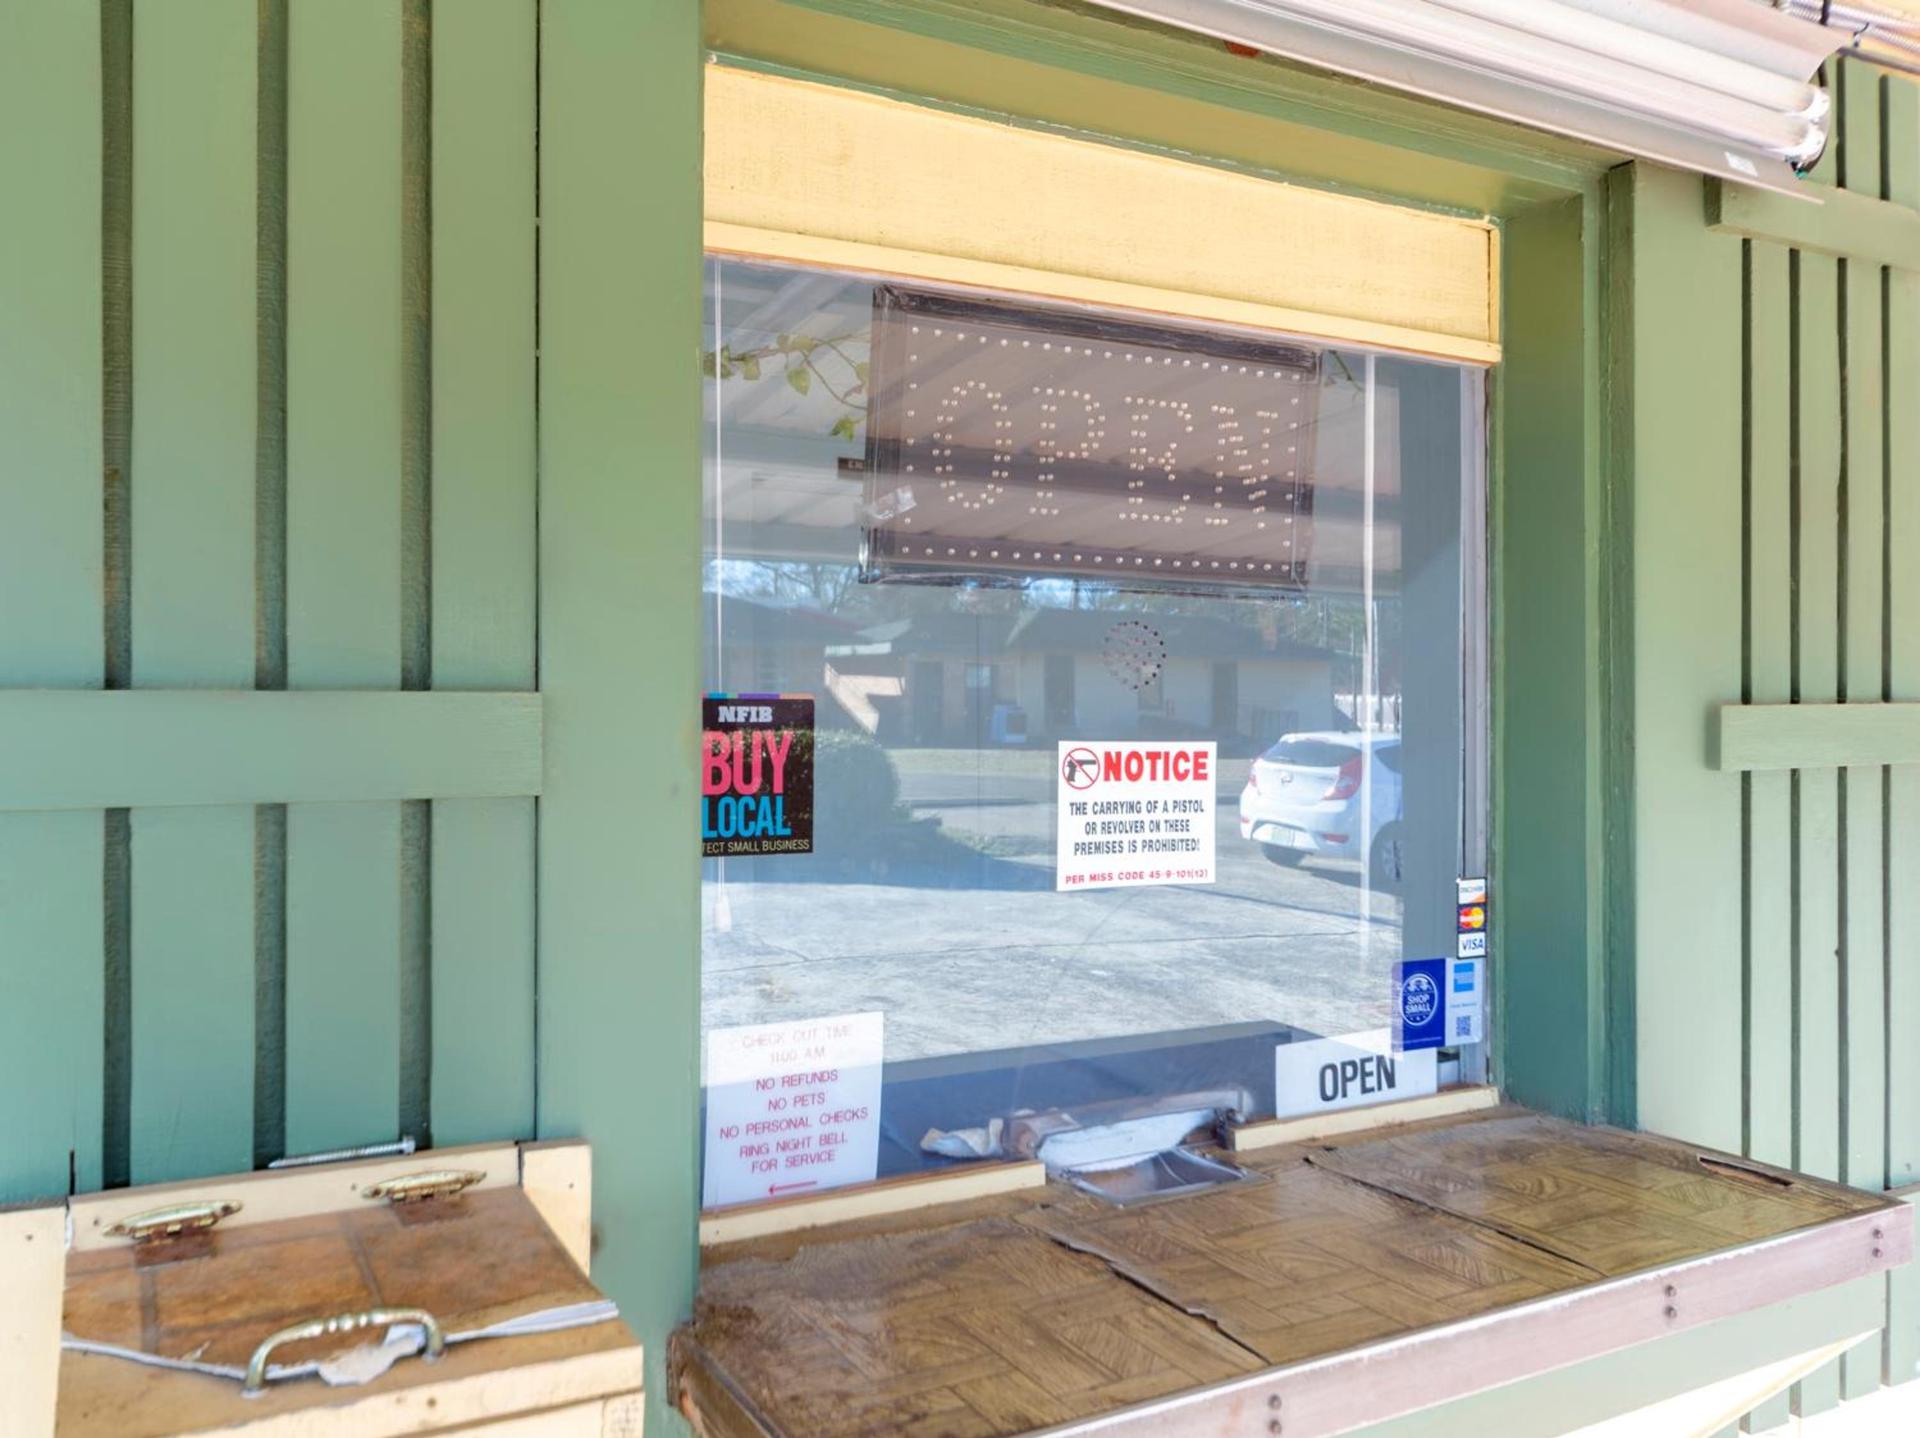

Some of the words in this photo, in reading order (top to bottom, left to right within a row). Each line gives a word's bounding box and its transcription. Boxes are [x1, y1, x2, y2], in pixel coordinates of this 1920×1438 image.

[718, 706, 773, 723] NFIB
[702, 730, 794, 796] BUY
[1103, 750, 1209, 783] NOTICE
[1069, 802, 1088, 816] THE
[1092, 800, 1142, 815] CARRYING
[1146, 800, 1159, 814] OF
[1162, 800, 1169, 813] A
[1172, 799, 1205, 813] PISTOL
[702, 795, 792, 840] LOCAL
[1085, 821, 1097, 836] OR
[1101, 820, 1145, 835] REVOLVER
[1149, 820, 1161, 833] ON
[1164, 819, 1190, 832] THESE
[727, 841, 760, 853] SMALL
[762, 839, 810, 852] BUSINESS
[1074, 840, 1124, 856] PREMISES
[1128, 840, 1137, 854] IS
[1142, 838, 1200, 853] PROHIBITED!
[1065, 874, 1085, 885] PER
[1089, 872, 1113, 883] MISS
[1118, 871, 1144, 881] CODE
[1462, 937, 1484, 951] VISA
[1405, 1002, 1431, 1014] SMALL
[1407, 994, 1430, 1004] SHOP
[741, 1033, 785, 1049] CHECK
[793, 1029, 818, 1043] OUT
[756, 1077, 775, 1091] NO
[781, 1069, 839, 1088] REFUNDS
[1319, 1054, 1396, 1102] OPEN
[768, 1097, 787, 1111] NO
[793, 1092, 826, 1107] PETS
[720, 1125, 740, 1139] NO
[746, 1117, 812, 1135] PERSONAL
[819, 1107, 869, 1126] CHECKS
[739, 1142, 770, 1158] RING
[776, 1137, 811, 1153] NIGHT
[819, 1132, 848, 1145] BELL
[751, 1159, 778, 1173] FOR
[785, 1149, 836, 1168] SERVICE
